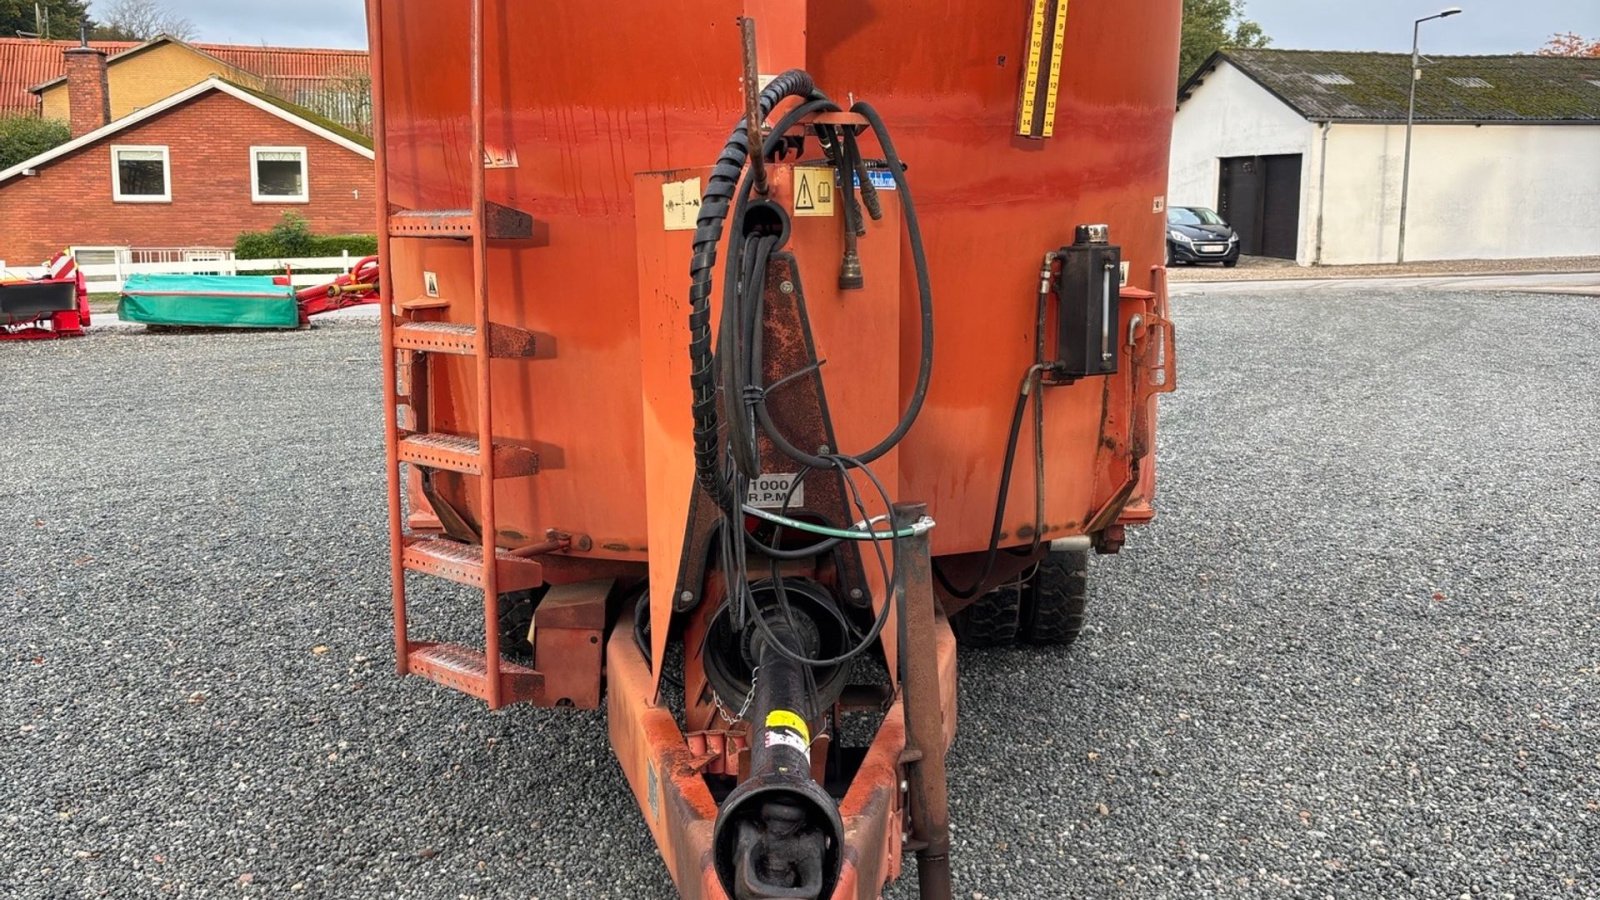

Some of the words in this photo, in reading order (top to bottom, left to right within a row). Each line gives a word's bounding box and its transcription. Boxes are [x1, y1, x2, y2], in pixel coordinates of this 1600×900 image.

[1036, 20, 1042, 28] 9
[1033, 40, 1041, 48] 10
[1054, 42, 1063, 50] 10
[1025, 99, 1033, 107] 13
[351, 189, 359, 200] 1
[750, 480, 789, 491] 1000
